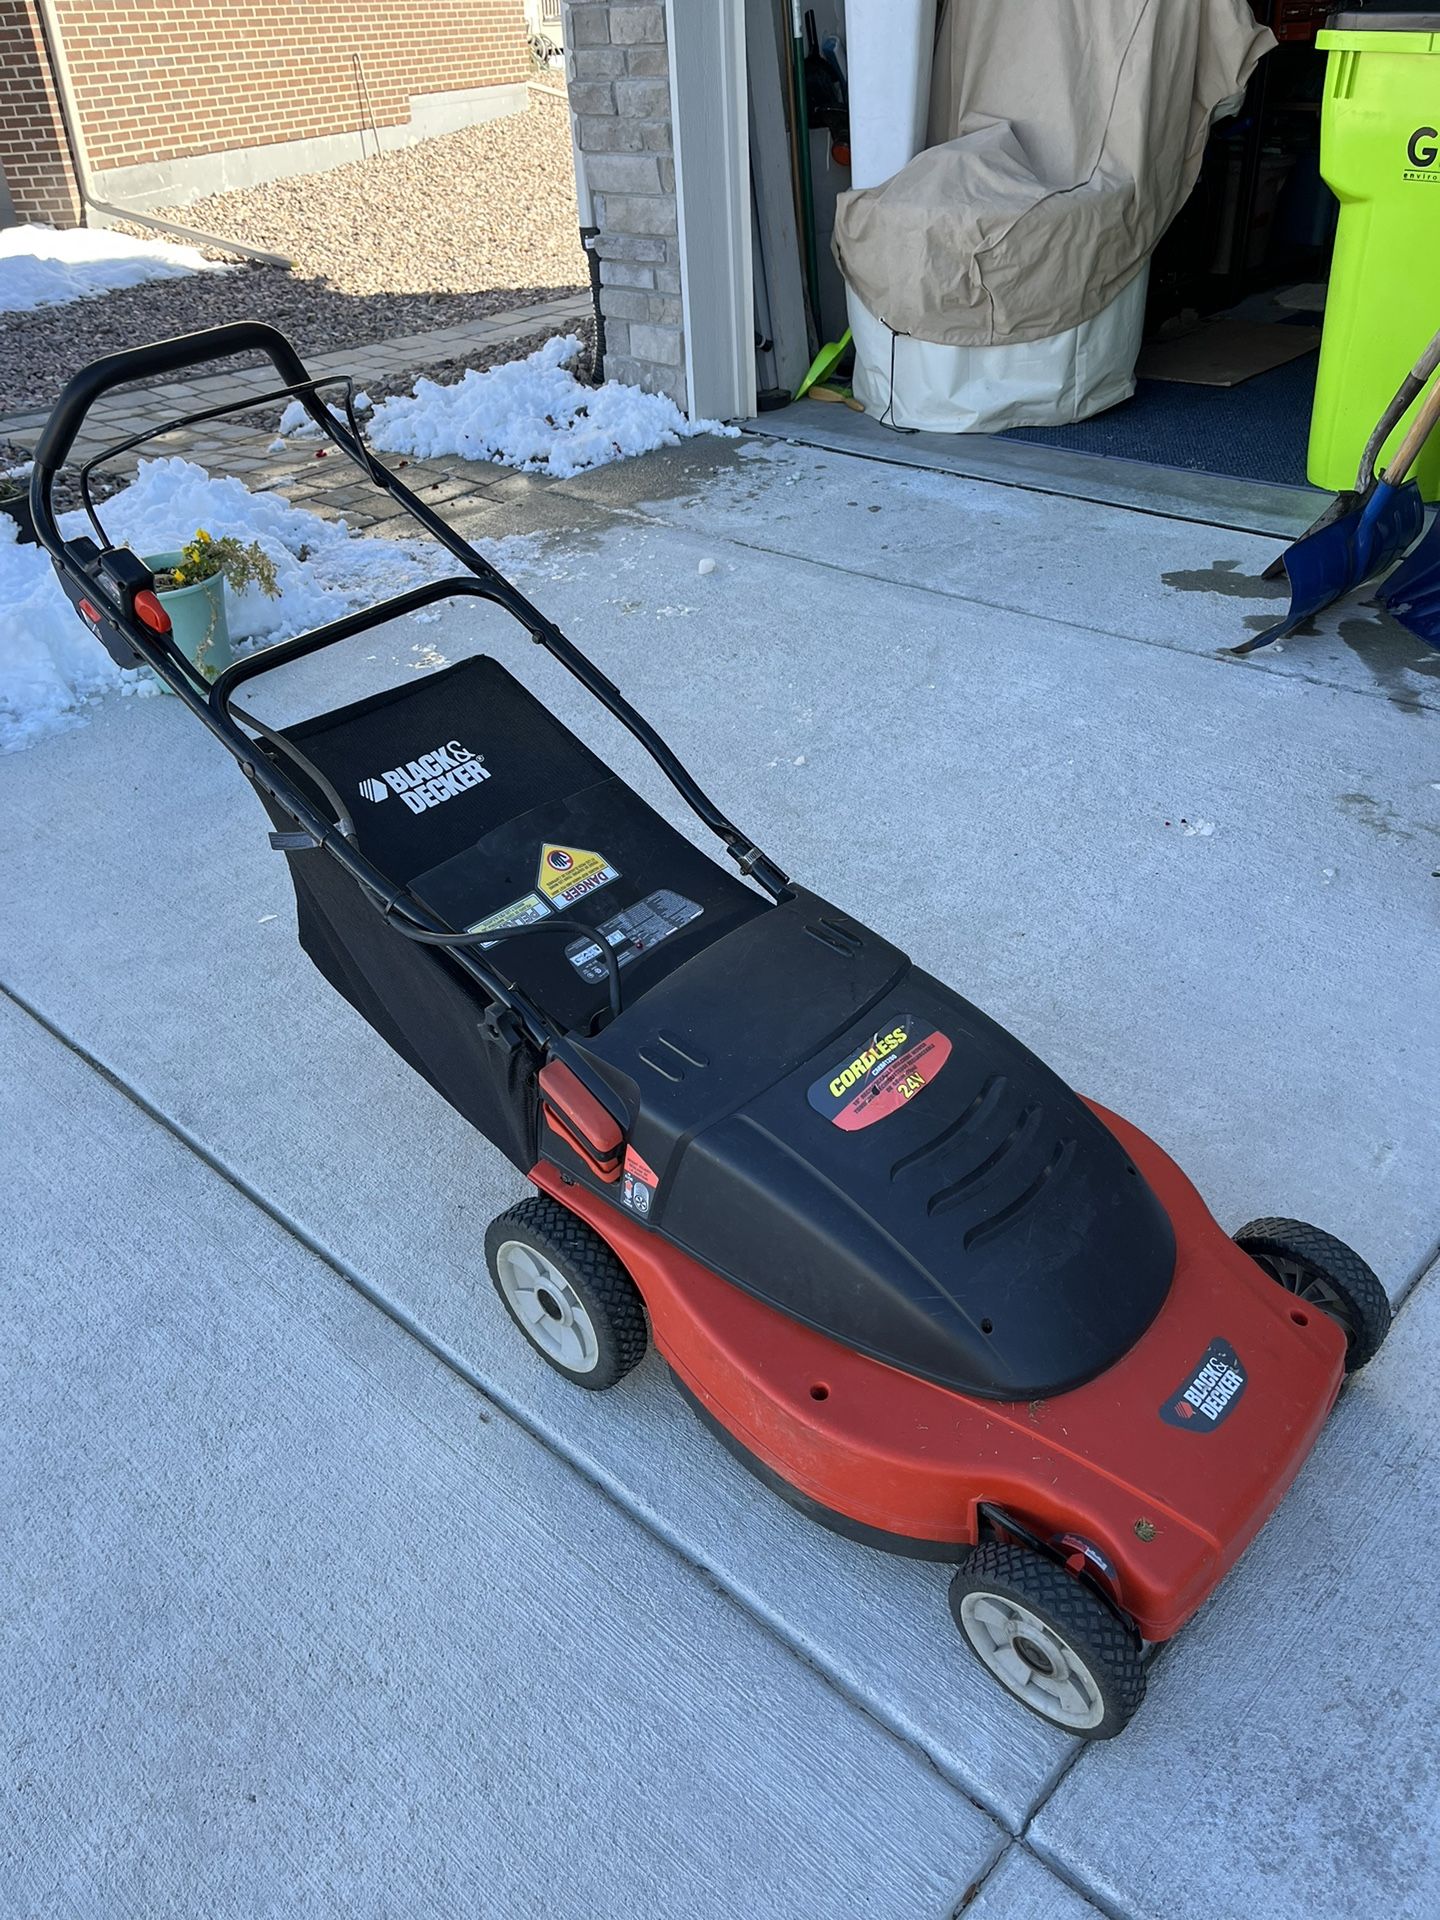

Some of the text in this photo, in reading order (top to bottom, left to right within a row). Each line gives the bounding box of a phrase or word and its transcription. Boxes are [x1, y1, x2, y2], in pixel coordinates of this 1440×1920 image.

[1407, 126, 1440, 168] G
[400, 760, 492, 814] DECKER
[563, 870, 609, 902] DANGER
[829, 1027, 908, 1098] CORDLESS
[898, 1072, 926, 1099] 24V
[1199, 1369, 1244, 1421] DECKER
